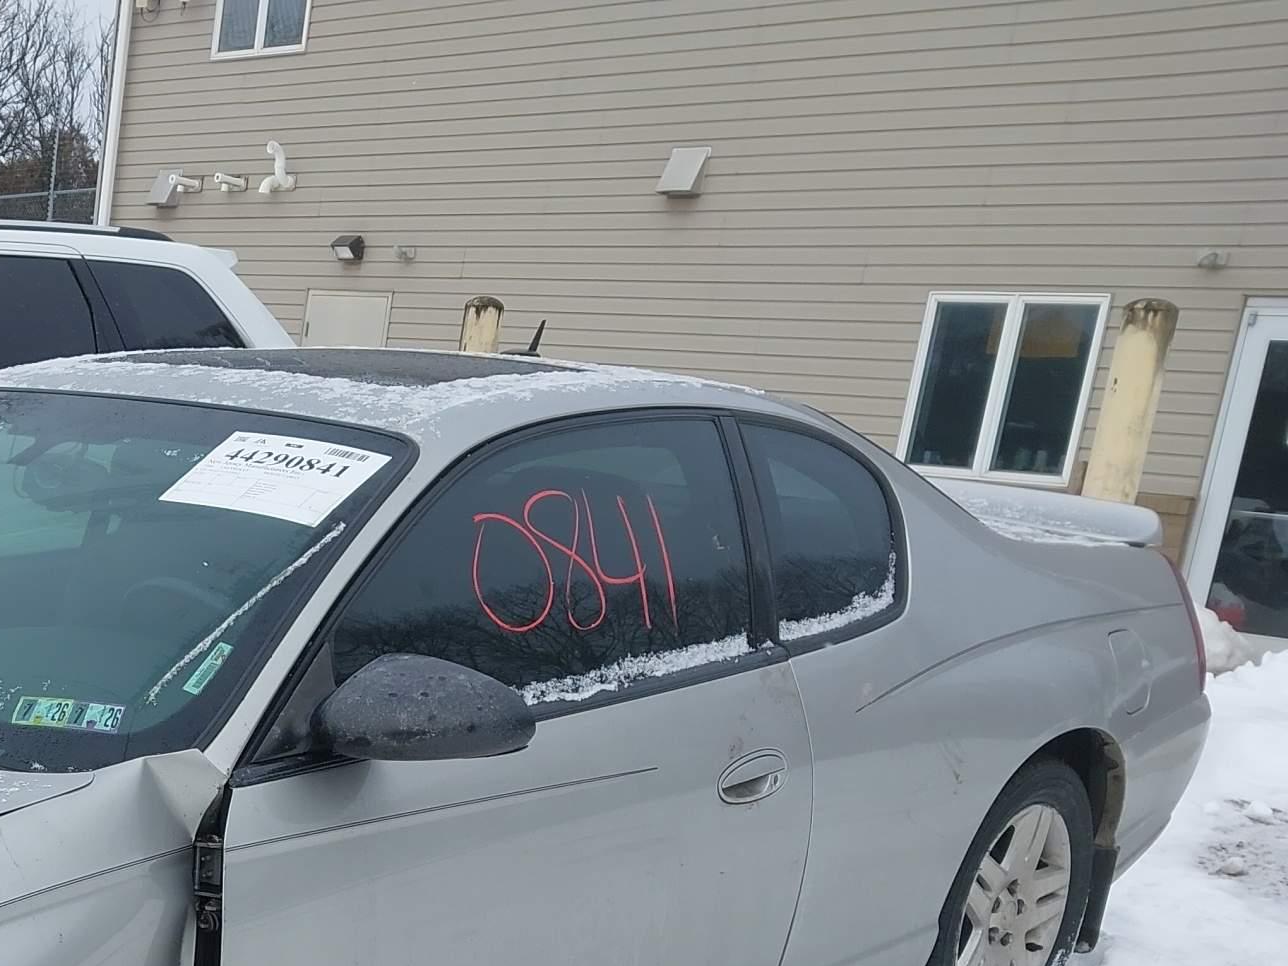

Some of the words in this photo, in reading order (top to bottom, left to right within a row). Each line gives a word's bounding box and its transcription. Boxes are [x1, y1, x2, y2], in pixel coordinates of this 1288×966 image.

[225, 448, 352, 479] 44290841
[472, 488, 678, 636] 0841
[51, 703, 70, 722] 26
[103, 708, 123, 729] 26
